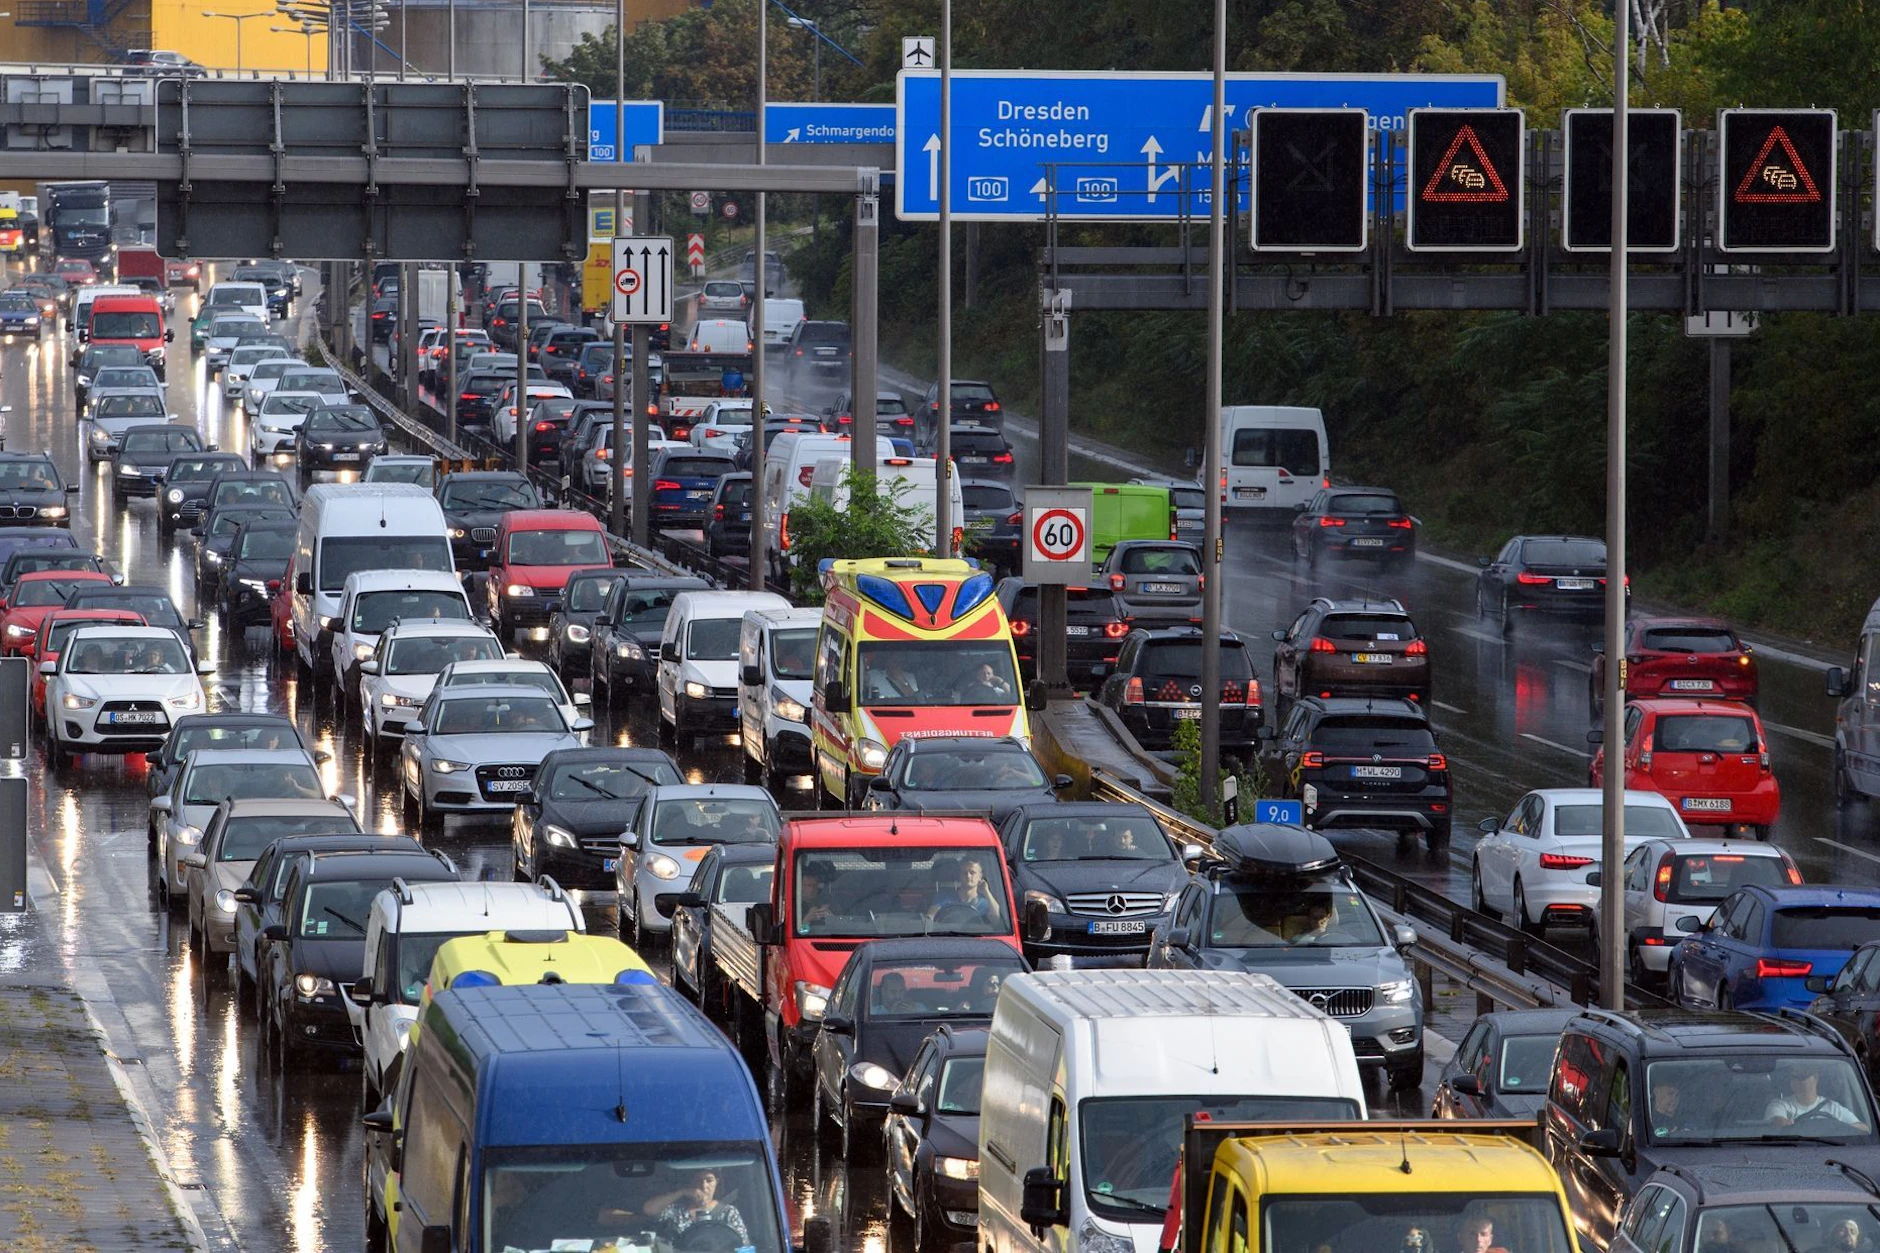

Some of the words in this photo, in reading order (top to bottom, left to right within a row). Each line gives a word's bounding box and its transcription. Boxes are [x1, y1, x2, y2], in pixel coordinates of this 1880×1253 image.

[998, 101, 1089, 120] Dresden
[806, 124, 895, 139] Schmargendo
[978, 127, 1110, 153] Schöneberg
[594, 148, 610, 157] 100
[975, 180, 1002, 198] 100
[1083, 180, 1111, 198] 100
[1044, 523, 1074, 547] 60
[1357, 653, 1367, 661] CV
[138, 712, 155, 722] 7022
[1367, 768, 1378, 776] WL
[1379, 768, 1400, 776] 4290
[492, 782, 504, 790] SV
[1697, 799, 1708, 808] MX
[1268, 806, 1289, 823] 9,0
[1106, 923, 1119, 932] FU
[1121, 922, 1144, 932] 8845
